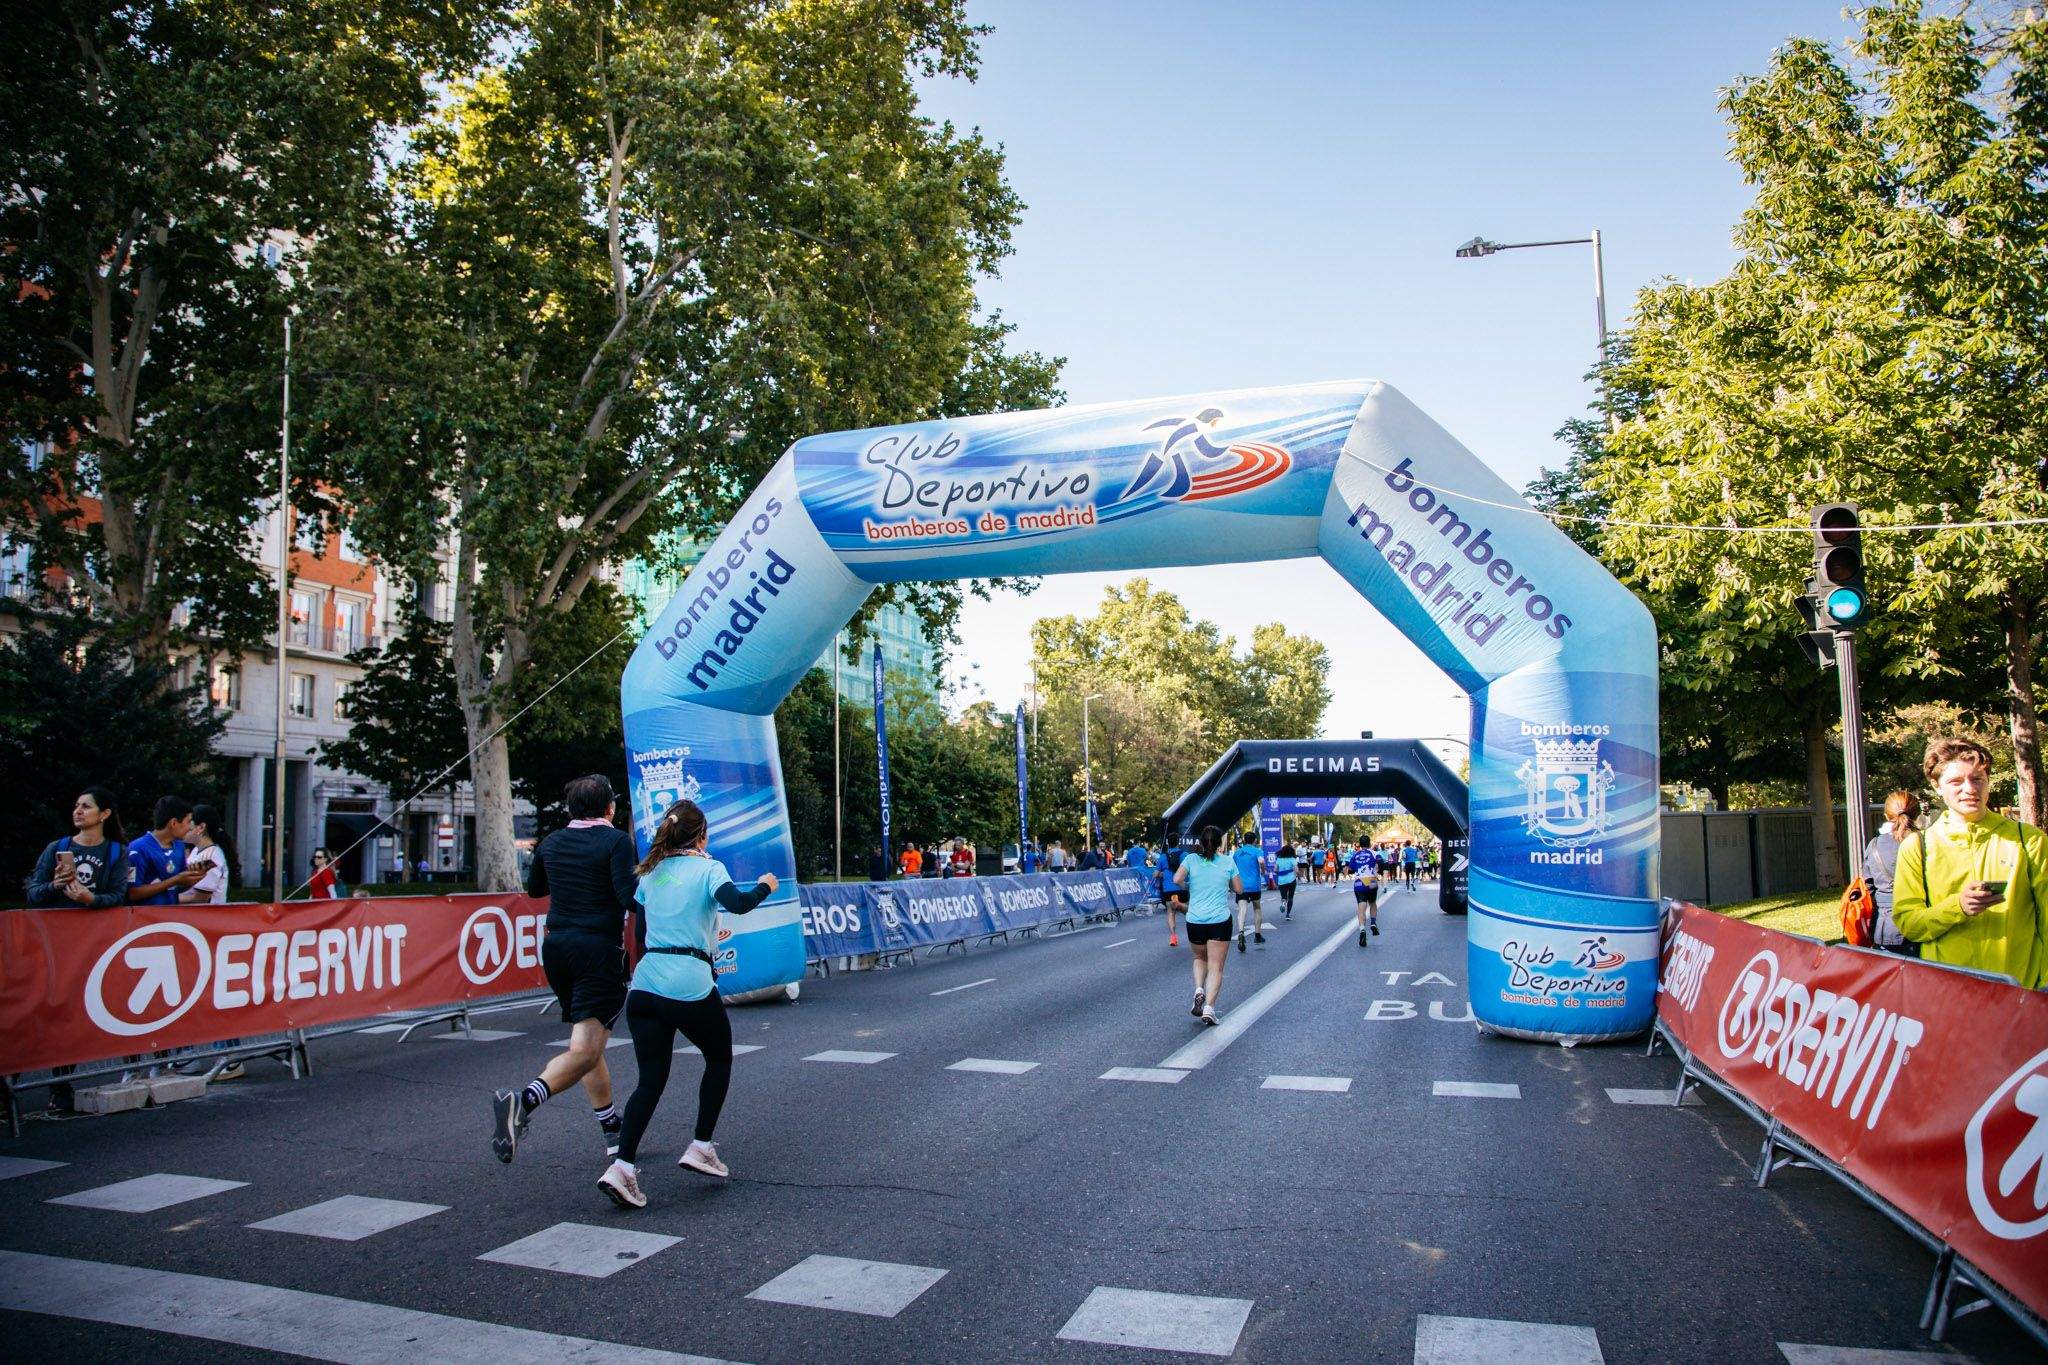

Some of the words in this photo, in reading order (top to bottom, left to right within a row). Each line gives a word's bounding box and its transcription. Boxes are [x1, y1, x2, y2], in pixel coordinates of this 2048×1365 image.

[866, 430, 962, 466] Club
[881, 462, 1090, 515] Deportivo
[865, 514, 968, 542] bomberos
[980, 512, 1006, 532] de
[1018, 504, 1095, 530] madrid
[1384, 457, 1574, 640] bomberos
[654, 494, 783, 661] bomberos
[1347, 502, 1508, 647] madrid
[687, 549, 796, 692] madrid
[1520, 721, 1610, 736] bomberos
[633, 746, 691, 763] bomberos
[1268, 756, 1381, 774] DECIMAS
[85, 854, 104, 867] ROCK
[1530, 848, 1603, 865] madrid
[909, 894, 978, 925] BOMBEROS
[213, 923, 407, 1010] ENERVIT
[1502, 941, 1555, 964] Club
[1511, 961, 1626, 996] Deportivo
[1664, 930, 1715, 1014] ENERVIT
[1363, 999, 1477, 1023] BU
[1501, 991, 1557, 1007] bomberos
[1564, 996, 1579, 1008] de
[1586, 995, 1626, 1008] madrid
[1752, 976, 1924, 1131] ENERVIT
